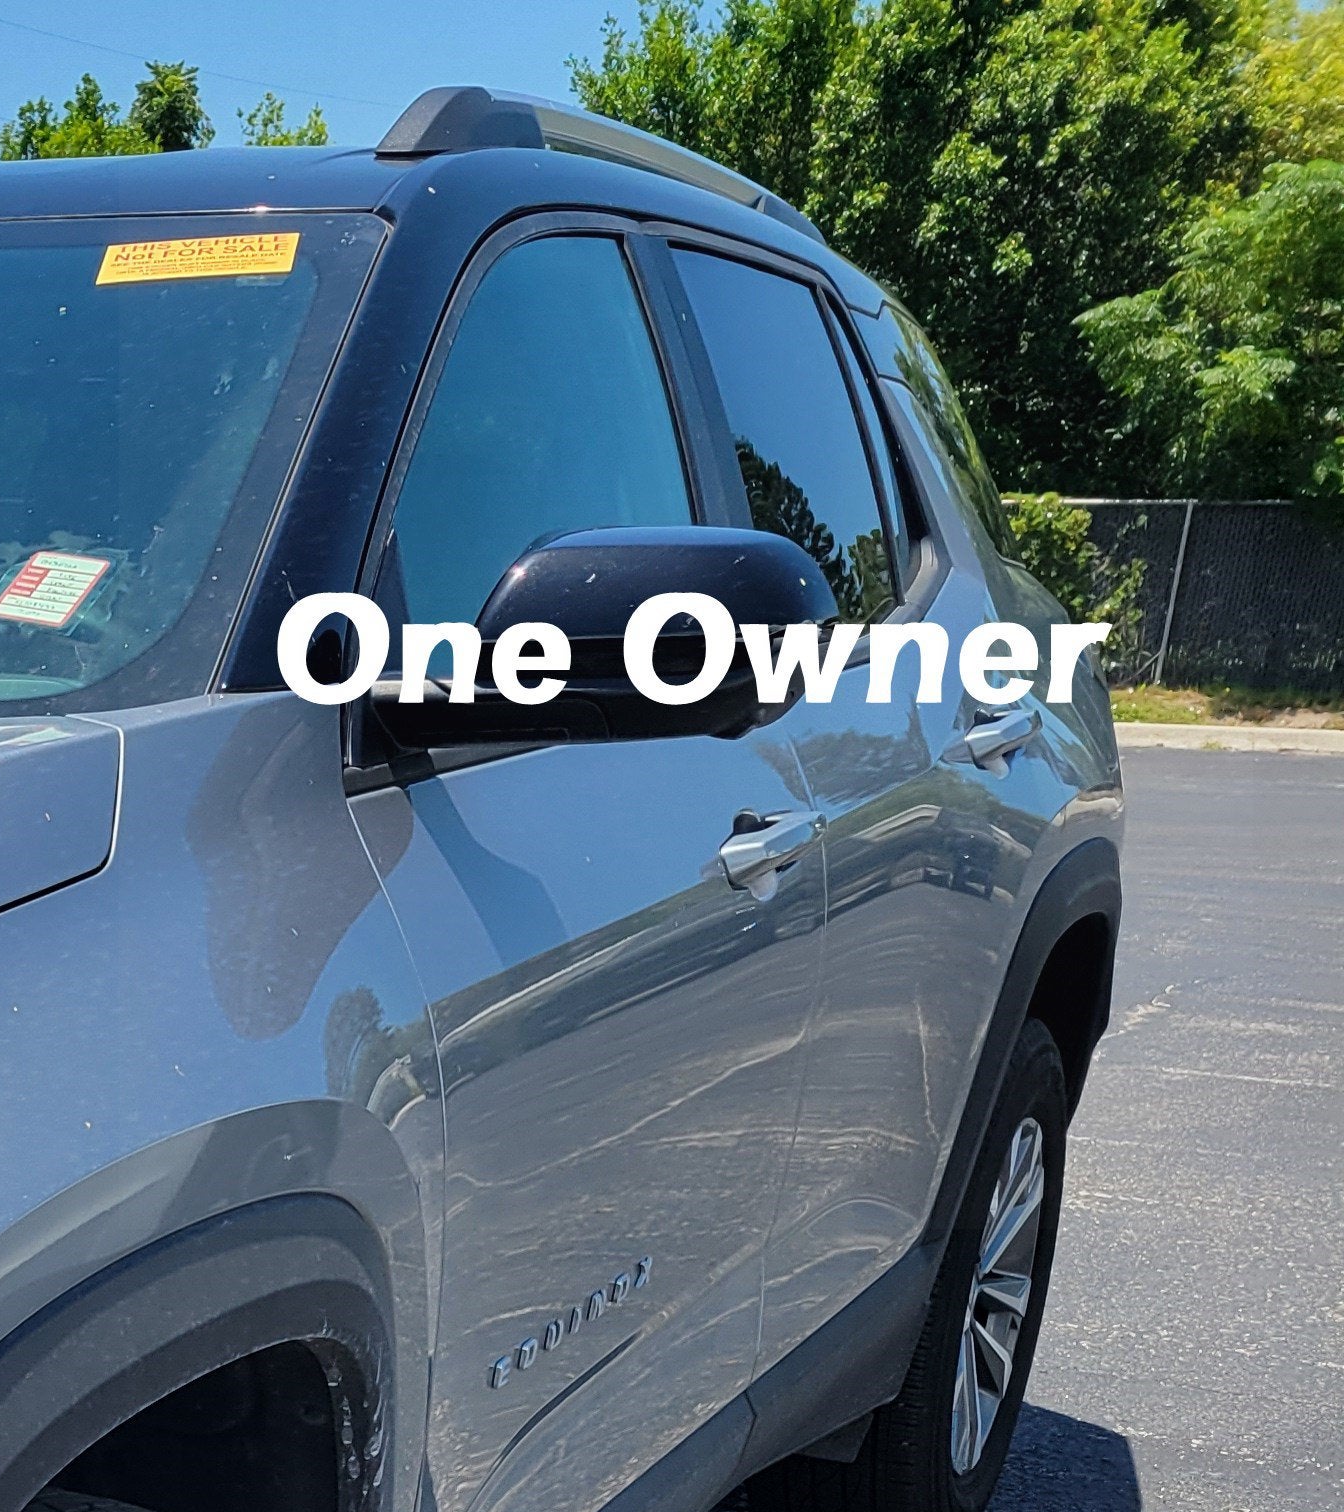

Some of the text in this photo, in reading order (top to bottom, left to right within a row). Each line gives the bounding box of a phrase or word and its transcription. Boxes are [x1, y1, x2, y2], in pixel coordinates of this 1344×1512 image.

[119, 235, 288, 253] THIS VEHICLE
[162, 247, 215, 258] FOR
[222, 242, 289, 254] SALE
[489, 1256, 653, 1390] EQUINOX
